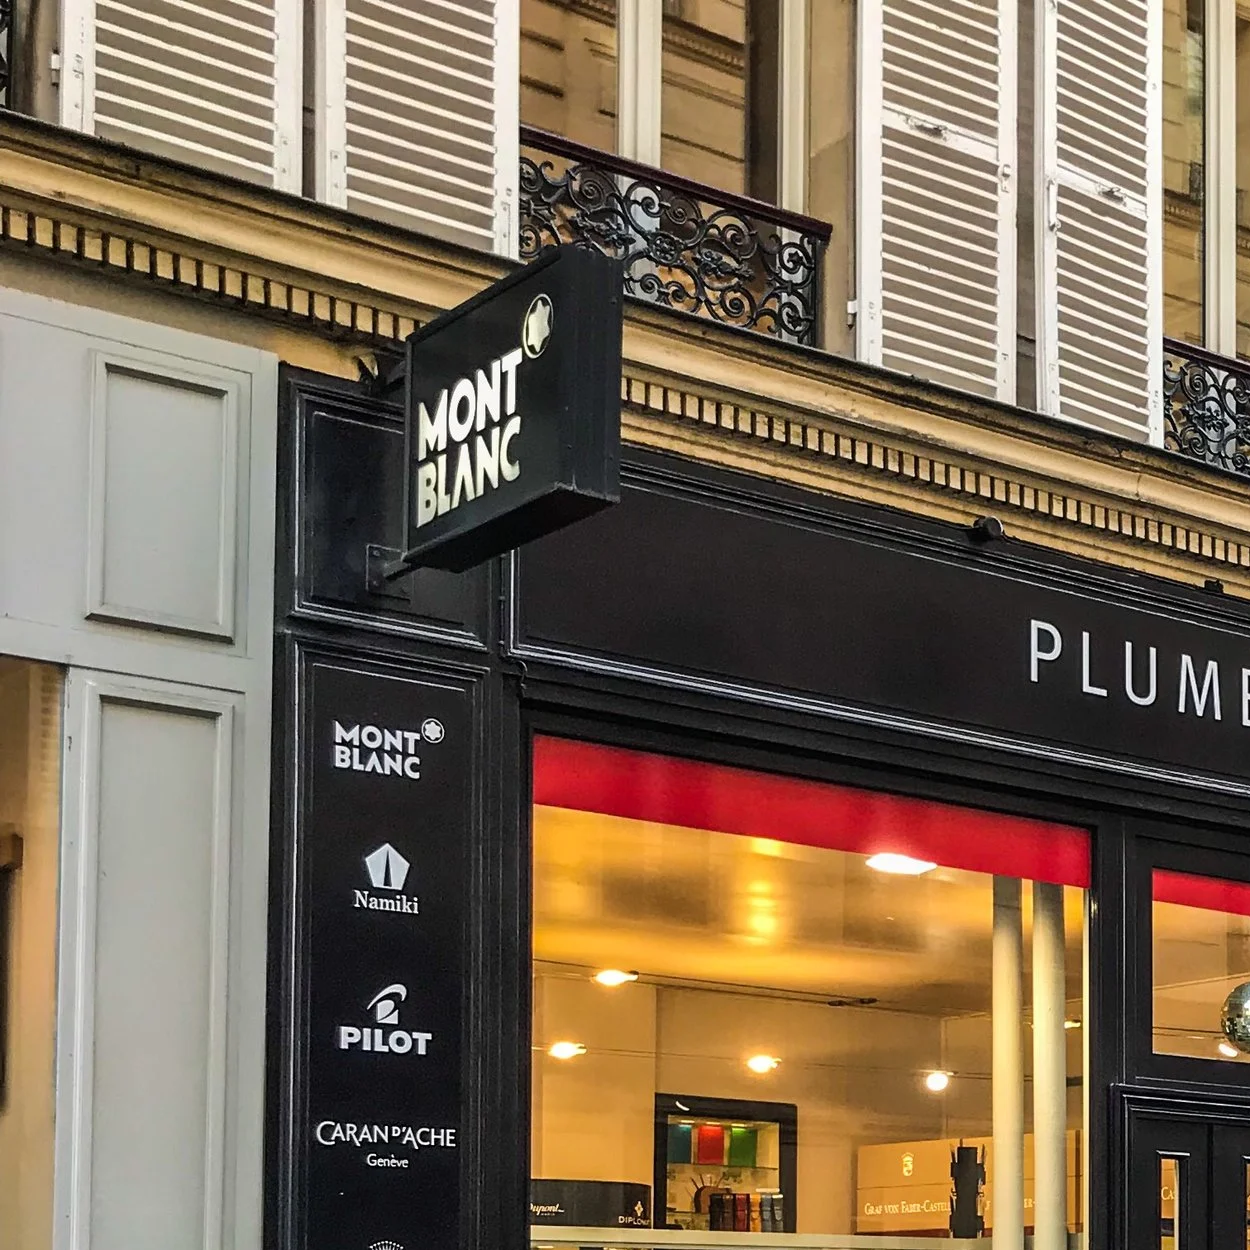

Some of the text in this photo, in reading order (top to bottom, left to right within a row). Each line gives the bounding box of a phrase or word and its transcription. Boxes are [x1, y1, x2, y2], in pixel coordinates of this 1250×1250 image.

[418, 347, 523, 461] MONT
[416, 416, 521, 528] BLANC
[333, 720, 421, 755] MONT
[334, 747, 421, 780] BLANC
[353, 890, 420, 914] Namiki
[339, 1026, 432, 1055] PILOT
[366, 1153, 409, 1168] Genève
